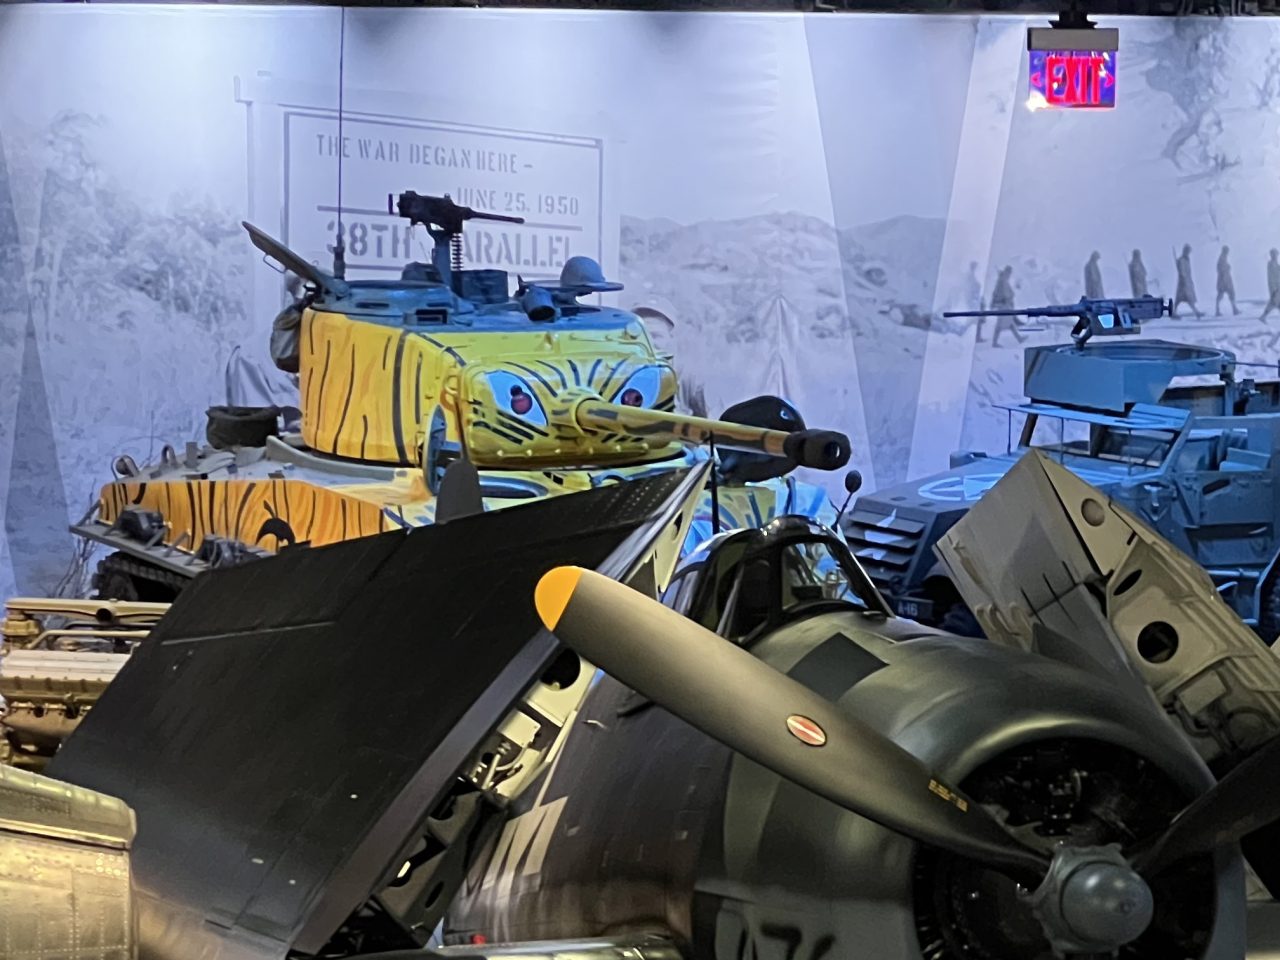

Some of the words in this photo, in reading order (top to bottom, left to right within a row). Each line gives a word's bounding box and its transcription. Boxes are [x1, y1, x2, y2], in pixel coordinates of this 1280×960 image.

[1045, 55, 1105, 105] EXIT
[316, 133, 351, 159] THE
[357, 138, 400, 163] WAR
[408, 143, 473, 170] BEGAN
[476, 150, 518, 174] HERE
[537, 193, 580, 217] 1950
[325, 219, 412, 260] 38TH
